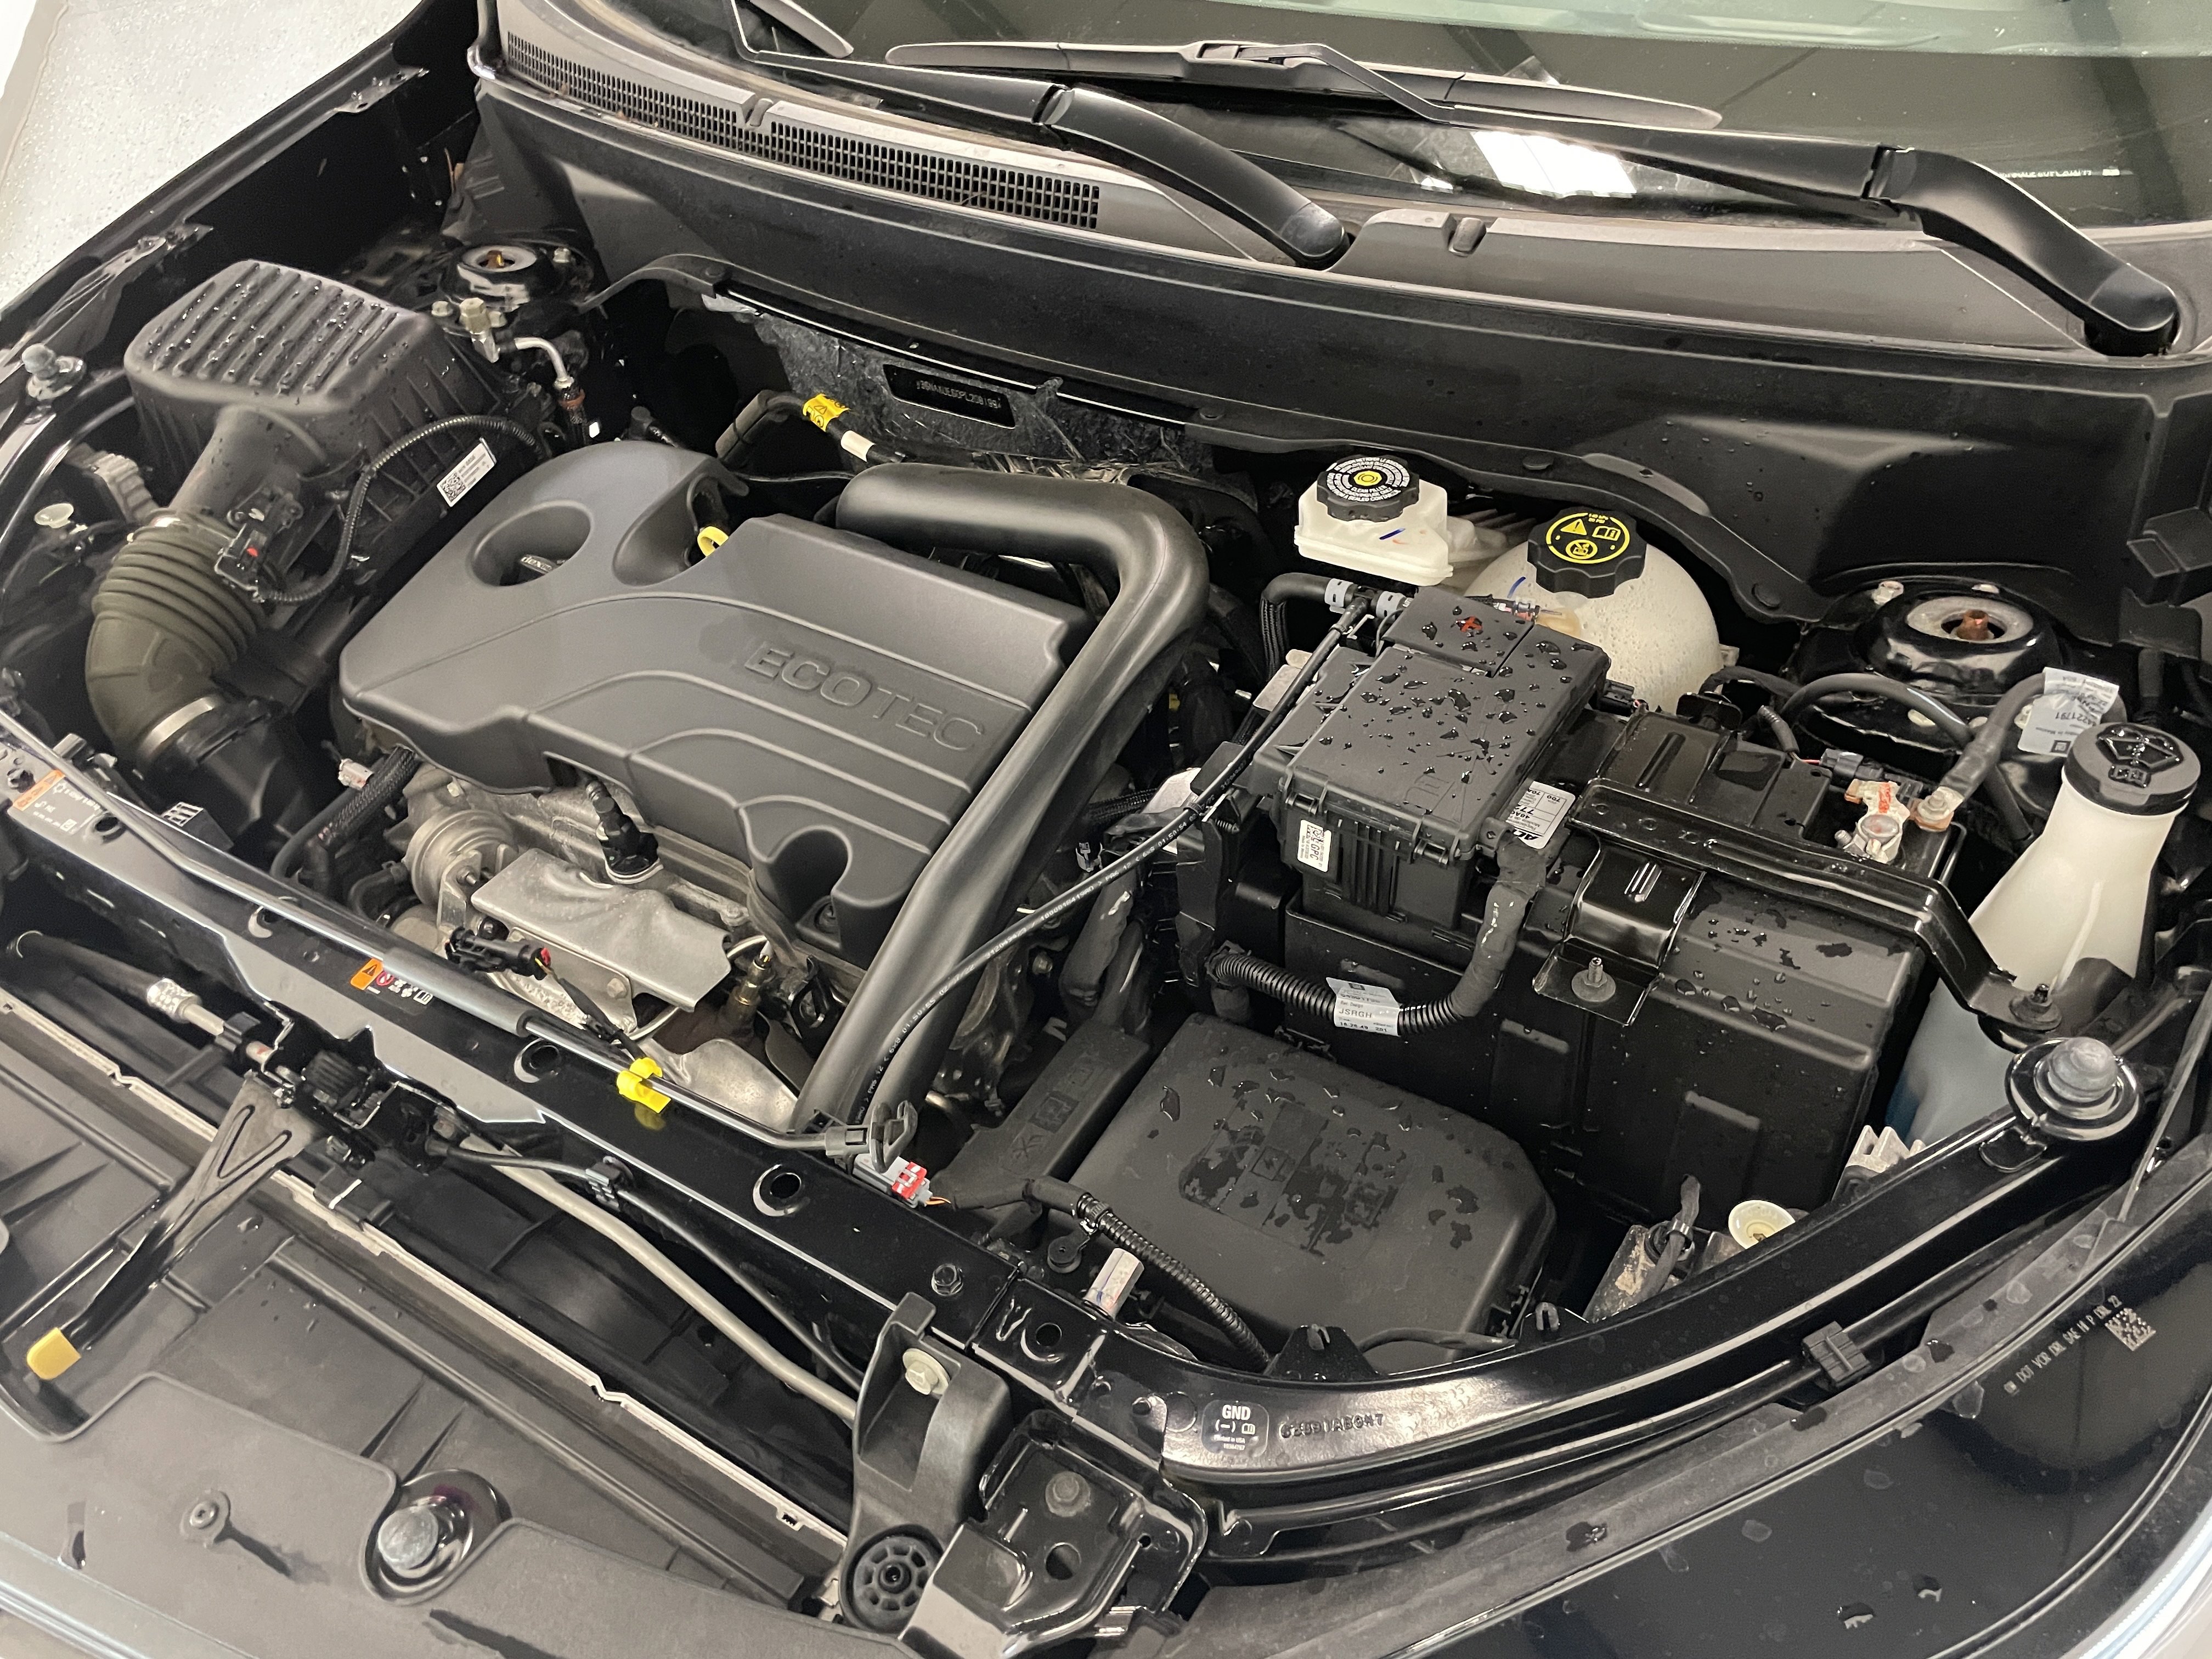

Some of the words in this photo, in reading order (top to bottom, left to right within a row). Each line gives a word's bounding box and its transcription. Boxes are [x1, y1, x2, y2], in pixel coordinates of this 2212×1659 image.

[744, 640, 985, 754] ECOTEC
[1547, 794, 1561, 803] 700
[1513, 829, 1539, 840] AC
[1310, 843, 1320, 861] GPC
[1339, 1008, 1373, 1018] JSRGH
[2015, 1364, 2034, 1383] DOT
[2062, 1328, 2081, 1345] SAE
[1221, 1404, 1251, 1420] GND
